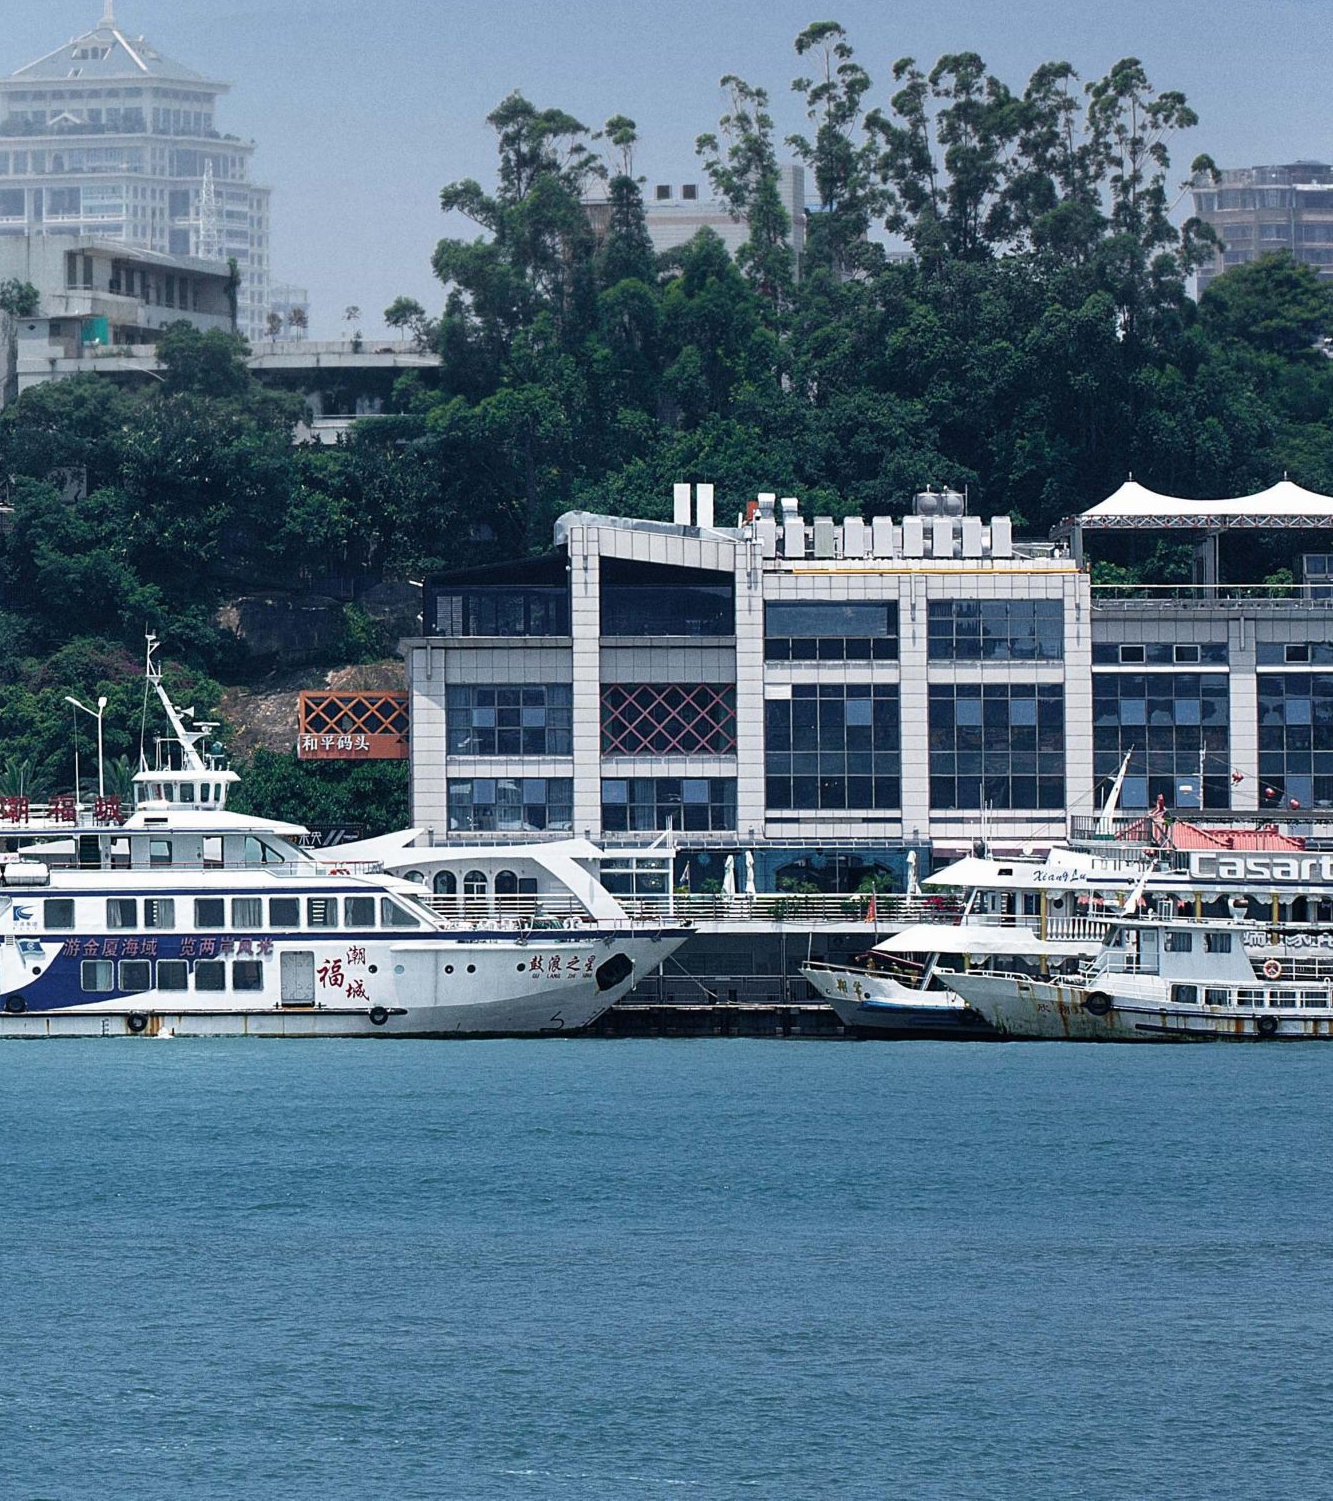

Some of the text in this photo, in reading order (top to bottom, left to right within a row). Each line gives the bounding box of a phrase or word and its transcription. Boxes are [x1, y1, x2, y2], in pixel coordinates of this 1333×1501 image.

[301, 735, 371, 751] 和平码头
[1189, 852, 1333, 881] Casart
[63, 936, 274, 957] 游金厦海域 览两岸风光
